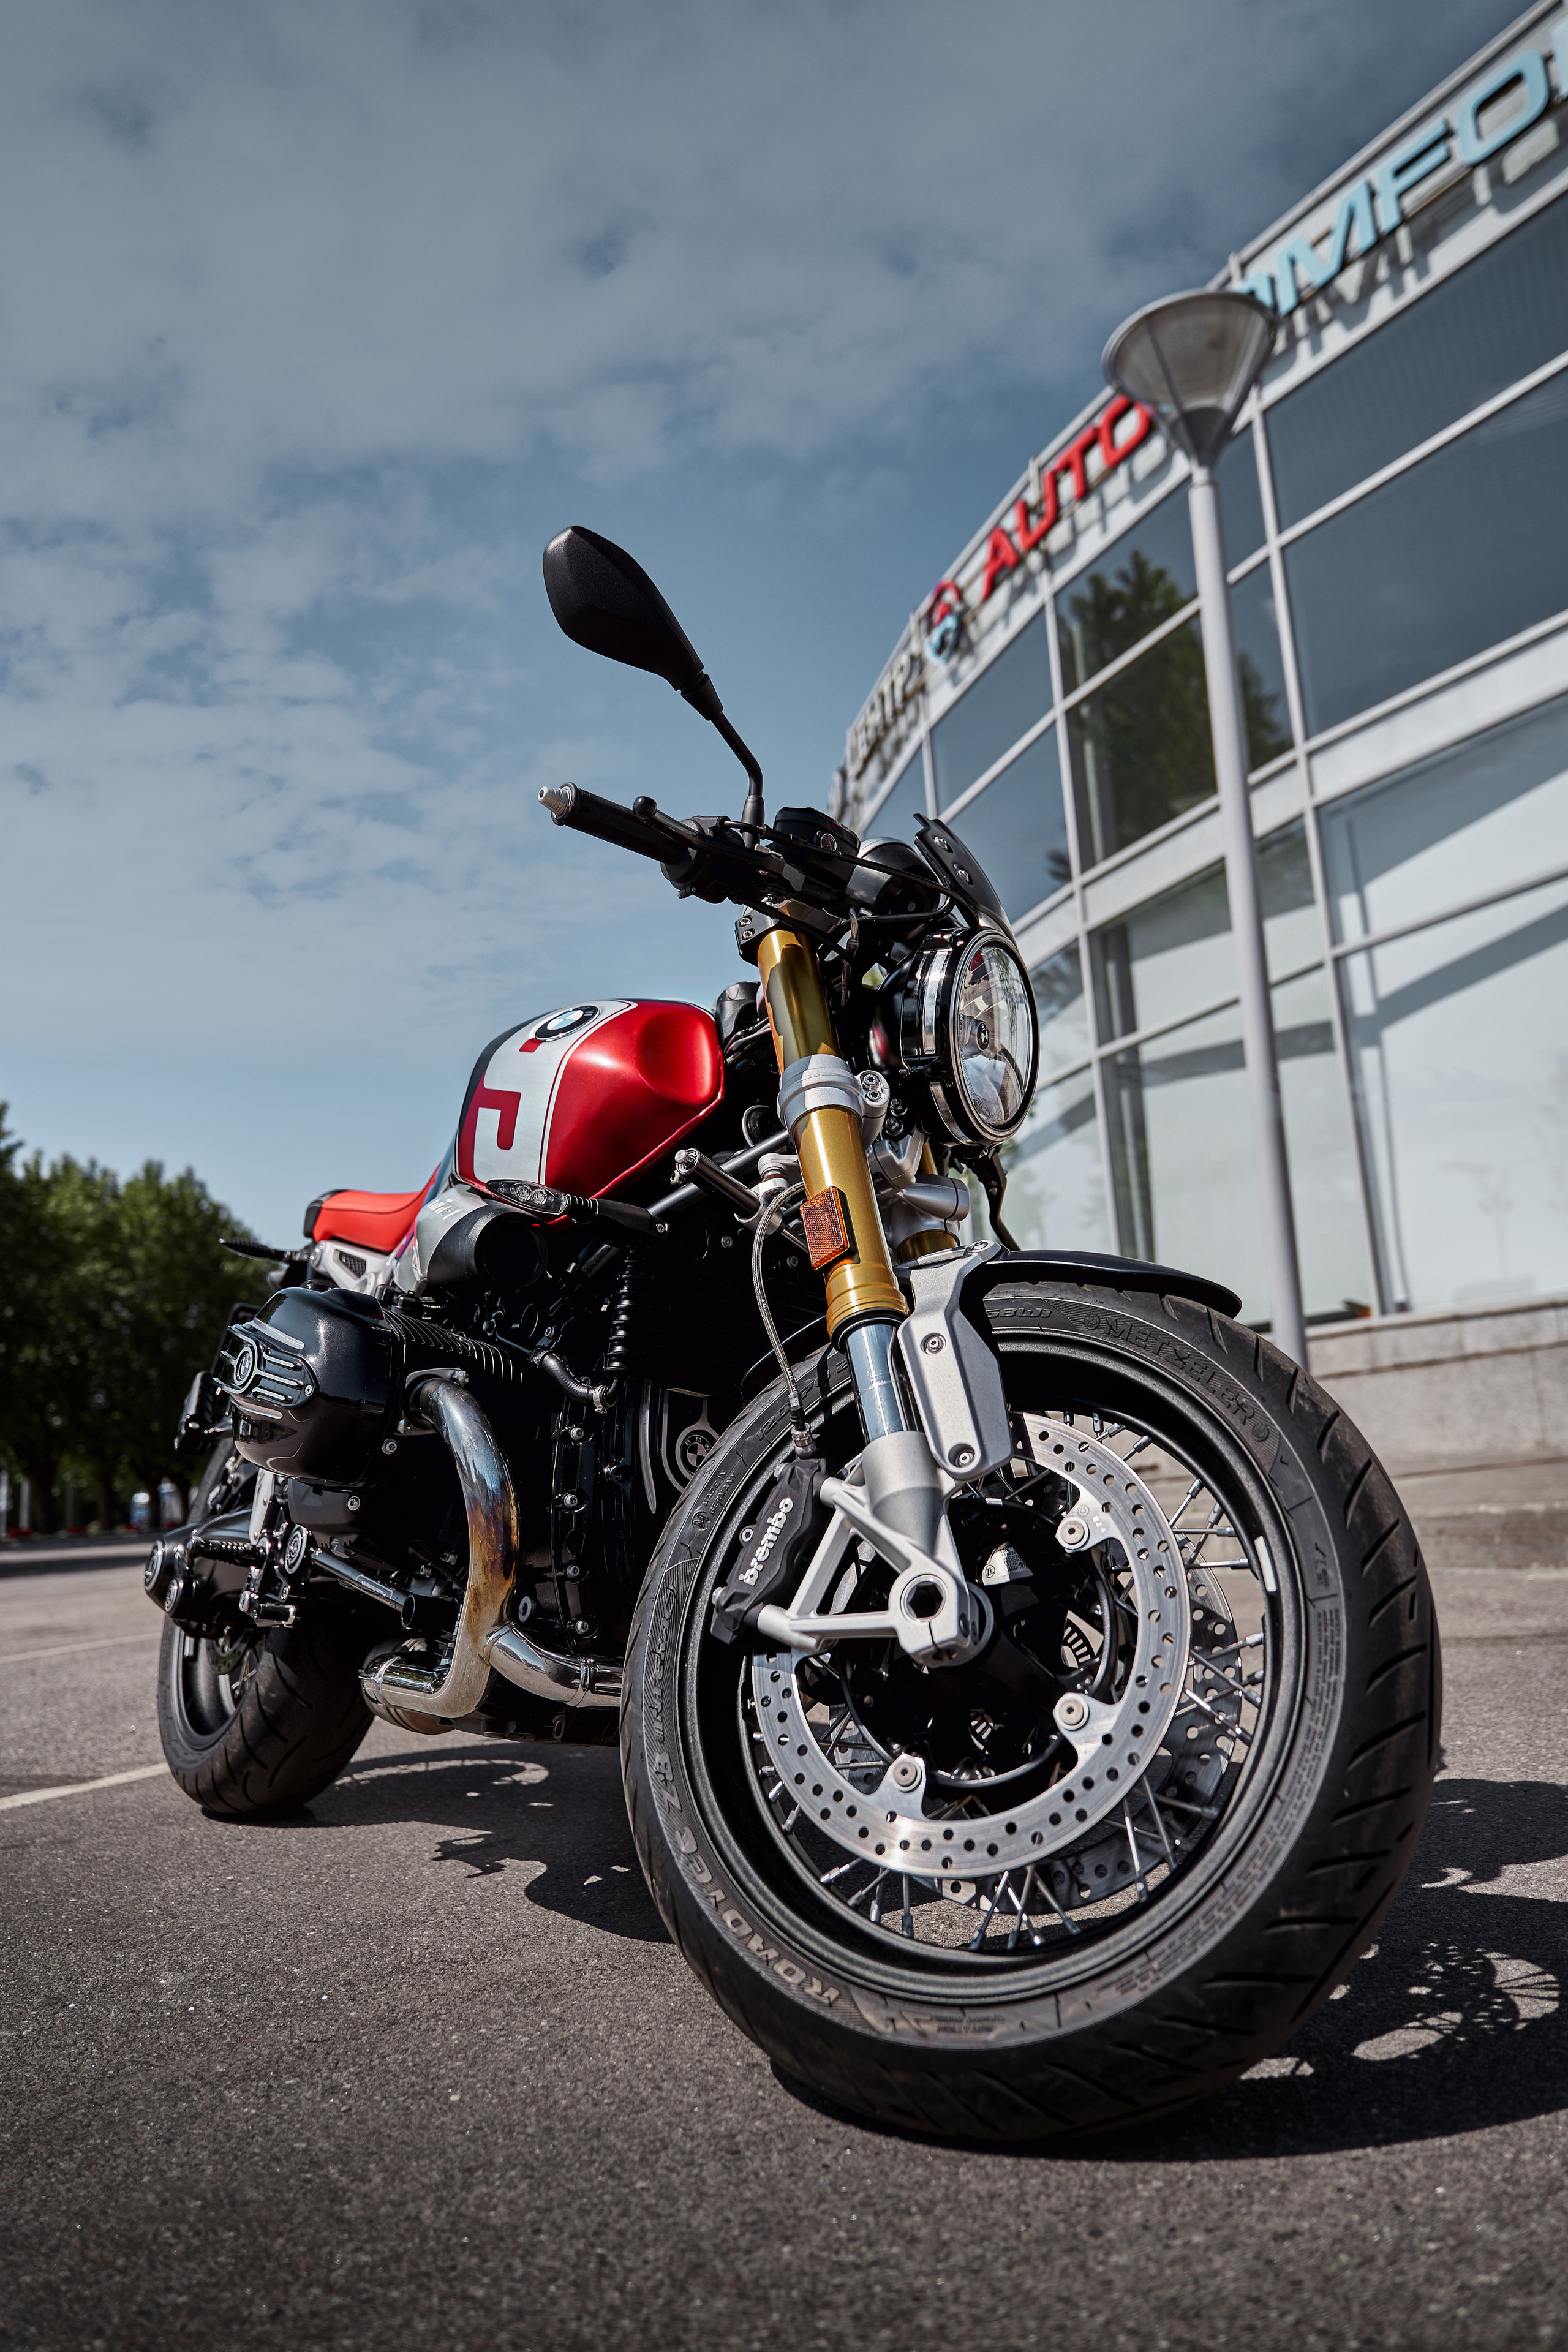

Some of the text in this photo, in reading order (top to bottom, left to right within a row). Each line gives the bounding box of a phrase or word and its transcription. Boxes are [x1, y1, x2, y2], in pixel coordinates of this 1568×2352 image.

[981, 394, 1155, 603] AUTO
[1103, 1317, 1255, 1425] METZELER
[684, 1436, 712, 1452] BMW
[701, 1480, 720, 1507] MADE
[717, 1469, 728, 1481] IN
[709, 1471, 738, 1515] GERMANY
[737, 1497, 793, 1587] brembo
[654, 1751, 682, 1814] Z8
[676, 1826, 842, 2007] ROADTEC
